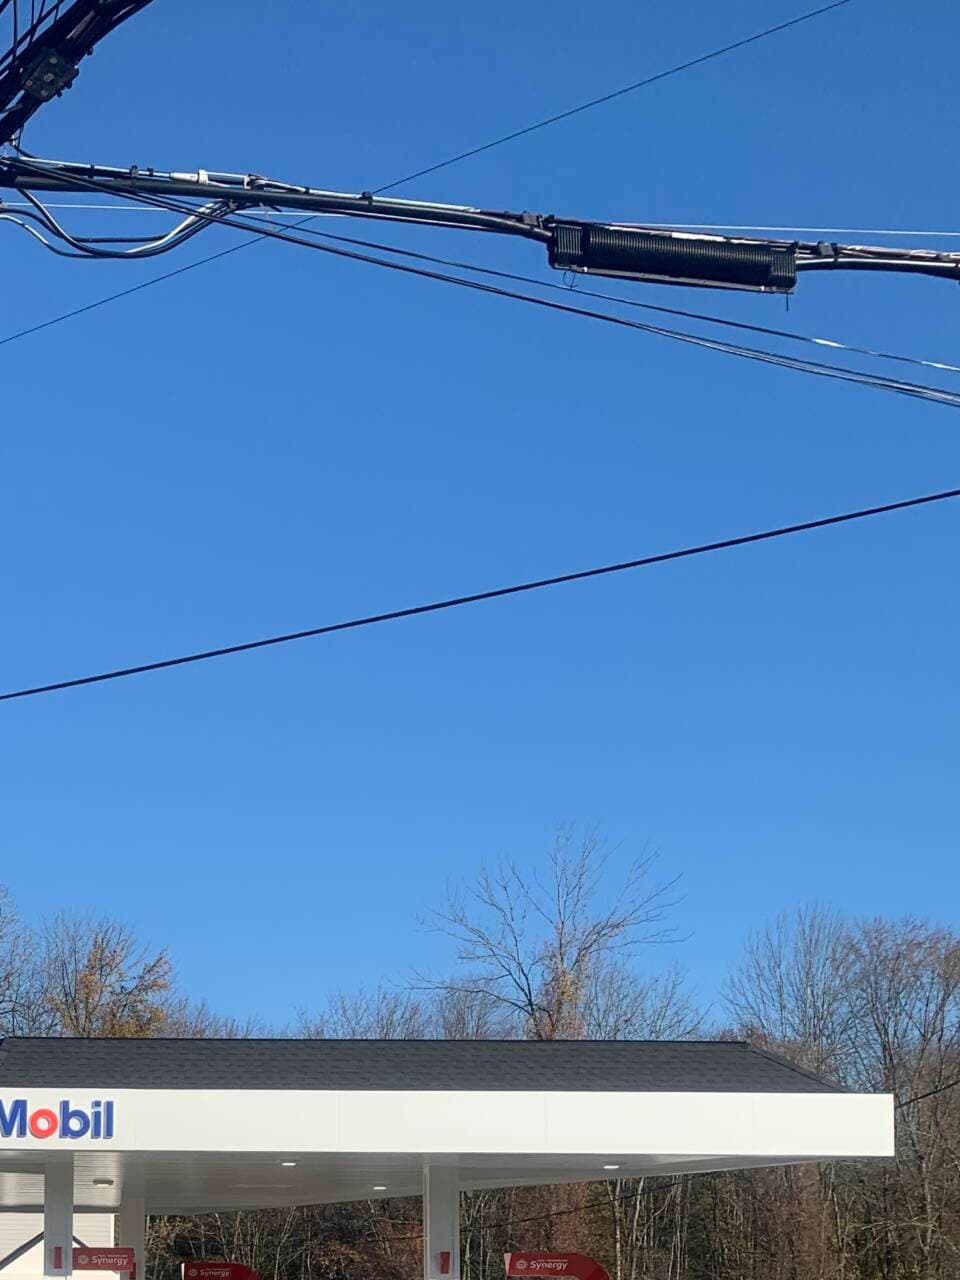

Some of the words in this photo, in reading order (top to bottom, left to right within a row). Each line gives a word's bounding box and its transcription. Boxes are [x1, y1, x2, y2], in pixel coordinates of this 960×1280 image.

[91, 1255, 128, 1266] Synergy
[530, 1260, 568, 1271] Synergy
[200, 1269, 230, 1278] Synergy
